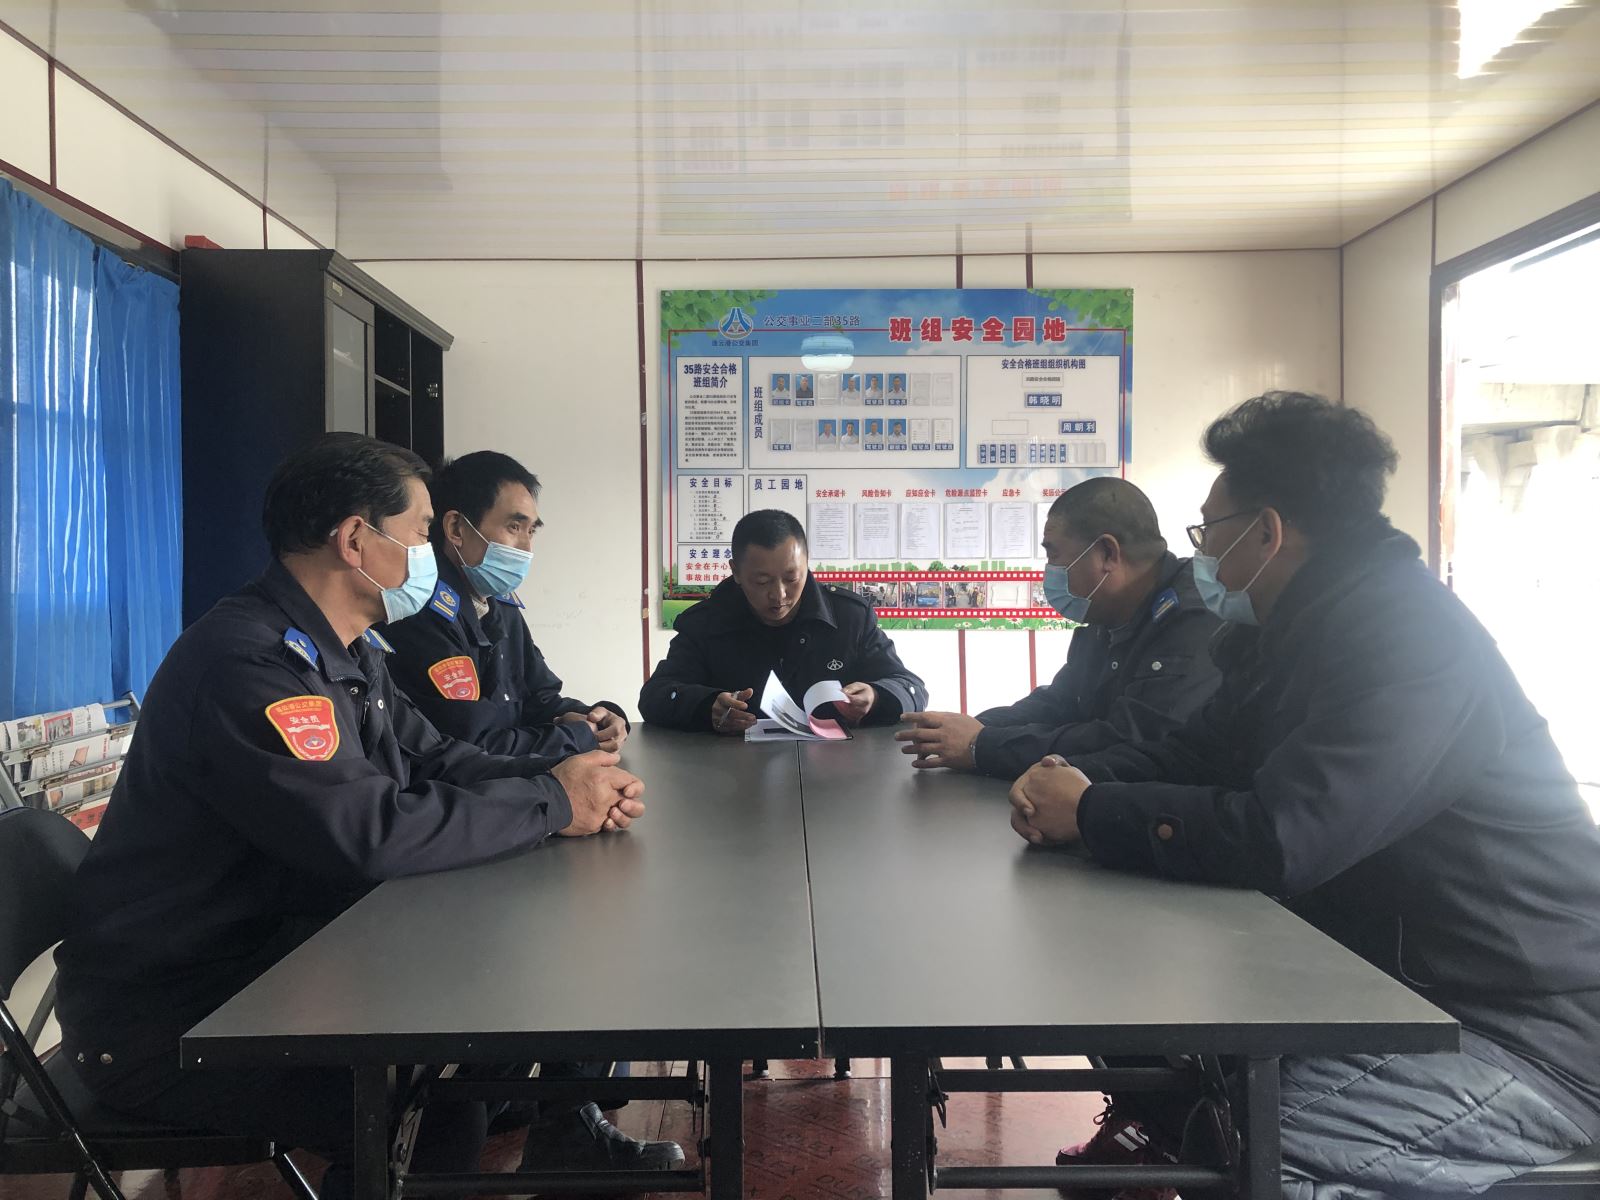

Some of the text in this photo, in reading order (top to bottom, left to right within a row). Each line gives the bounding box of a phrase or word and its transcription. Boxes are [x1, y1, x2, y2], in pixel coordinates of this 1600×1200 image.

[764, 315, 861, 327] 公交事业二部35路
[889, 317, 1067, 342] 班组安全园地
[684, 363, 737, 375] 35路安全合格
[1001, 358, 1086, 369] 安全合格班组组织机构图
[693, 376, 728, 388] 班组简介
[1028, 395, 1061, 405] 韩晓明
[753, 386, 763, 439] 班组成员
[689, 477, 732, 488] 安全目标
[754, 478, 803, 490] 员工园地
[1002, 488, 1021, 497] 应急卡
[689, 548, 732, 559] 安全理念
[686, 562, 731, 570] 安全在于心
[289, 714, 320, 725] 安全员
